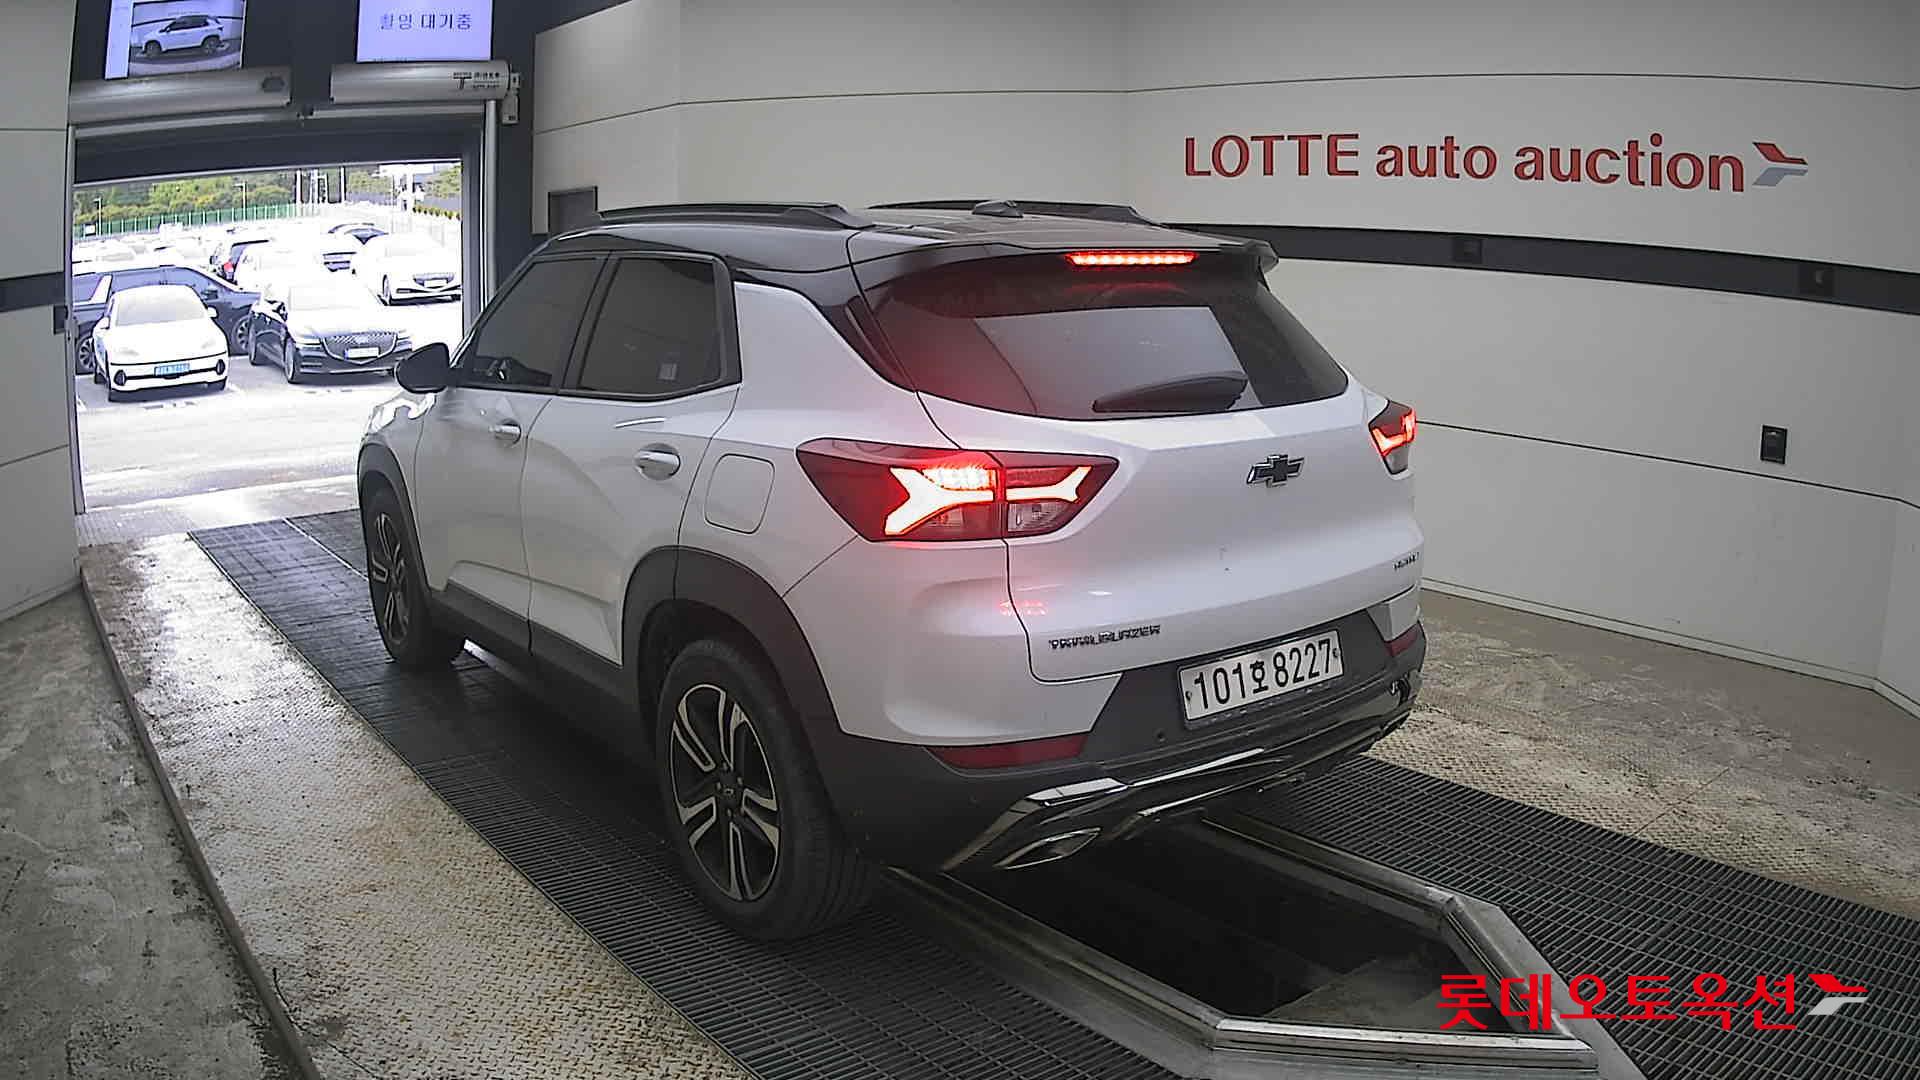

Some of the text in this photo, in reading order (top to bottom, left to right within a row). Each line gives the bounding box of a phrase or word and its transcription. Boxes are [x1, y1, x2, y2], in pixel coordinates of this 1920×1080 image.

[1184, 133, 1745, 193] LOTTE auto auction
